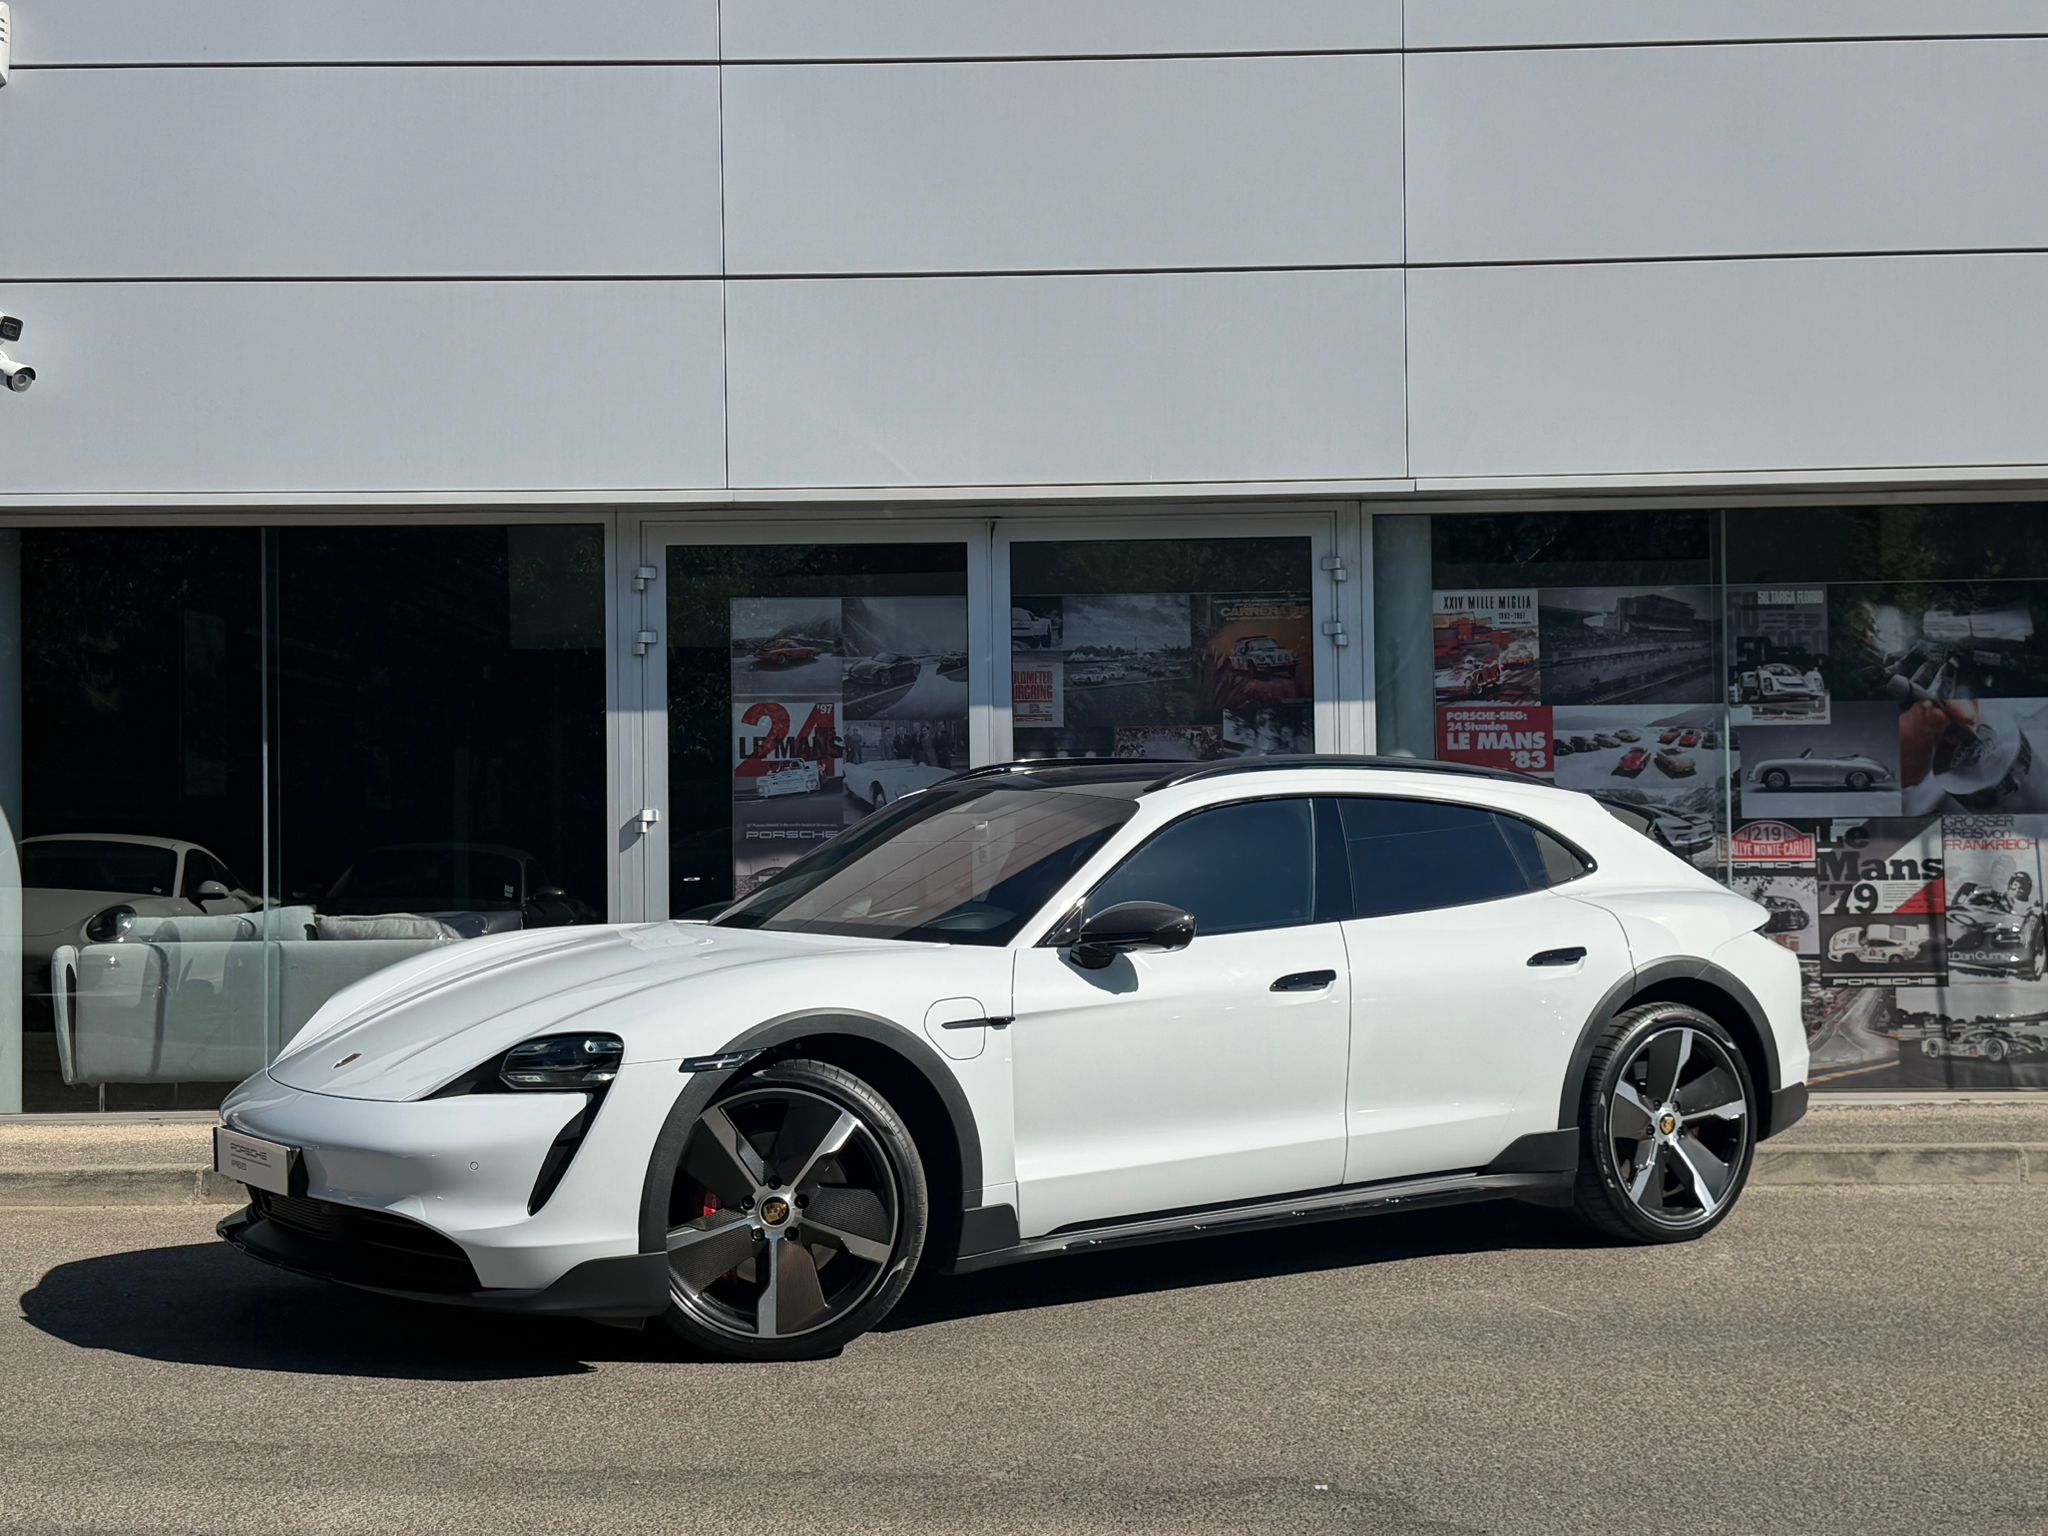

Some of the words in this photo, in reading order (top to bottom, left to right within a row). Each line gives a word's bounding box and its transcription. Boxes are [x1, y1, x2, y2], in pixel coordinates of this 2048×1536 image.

[1443, 596, 1463, 609] XXIV
[1468, 596, 1494, 608] MILLE
[1498, 595, 1531, 608] MIGLIA
[1446, 711, 1528, 721] PORSCHE-SIEG:
[1447, 722, 1462, 731] 24
[1464, 721, 1508, 731] Stunden
[1446, 732, 1471, 750] LE
[1477, 731, 1547, 750] MANS
[1510, 751, 1547, 769] '83
[1943, 815, 2013, 828] GROSSER
[745, 830, 839, 840] PORSCHE
[1751, 826, 1782, 841] 219
[1815, 819, 1869, 849] Le
[1943, 839, 2037, 850] FRANKREICH
[1817, 851, 1943, 881] Mans
[1832, 977, 1937, 987] PORSCHE
